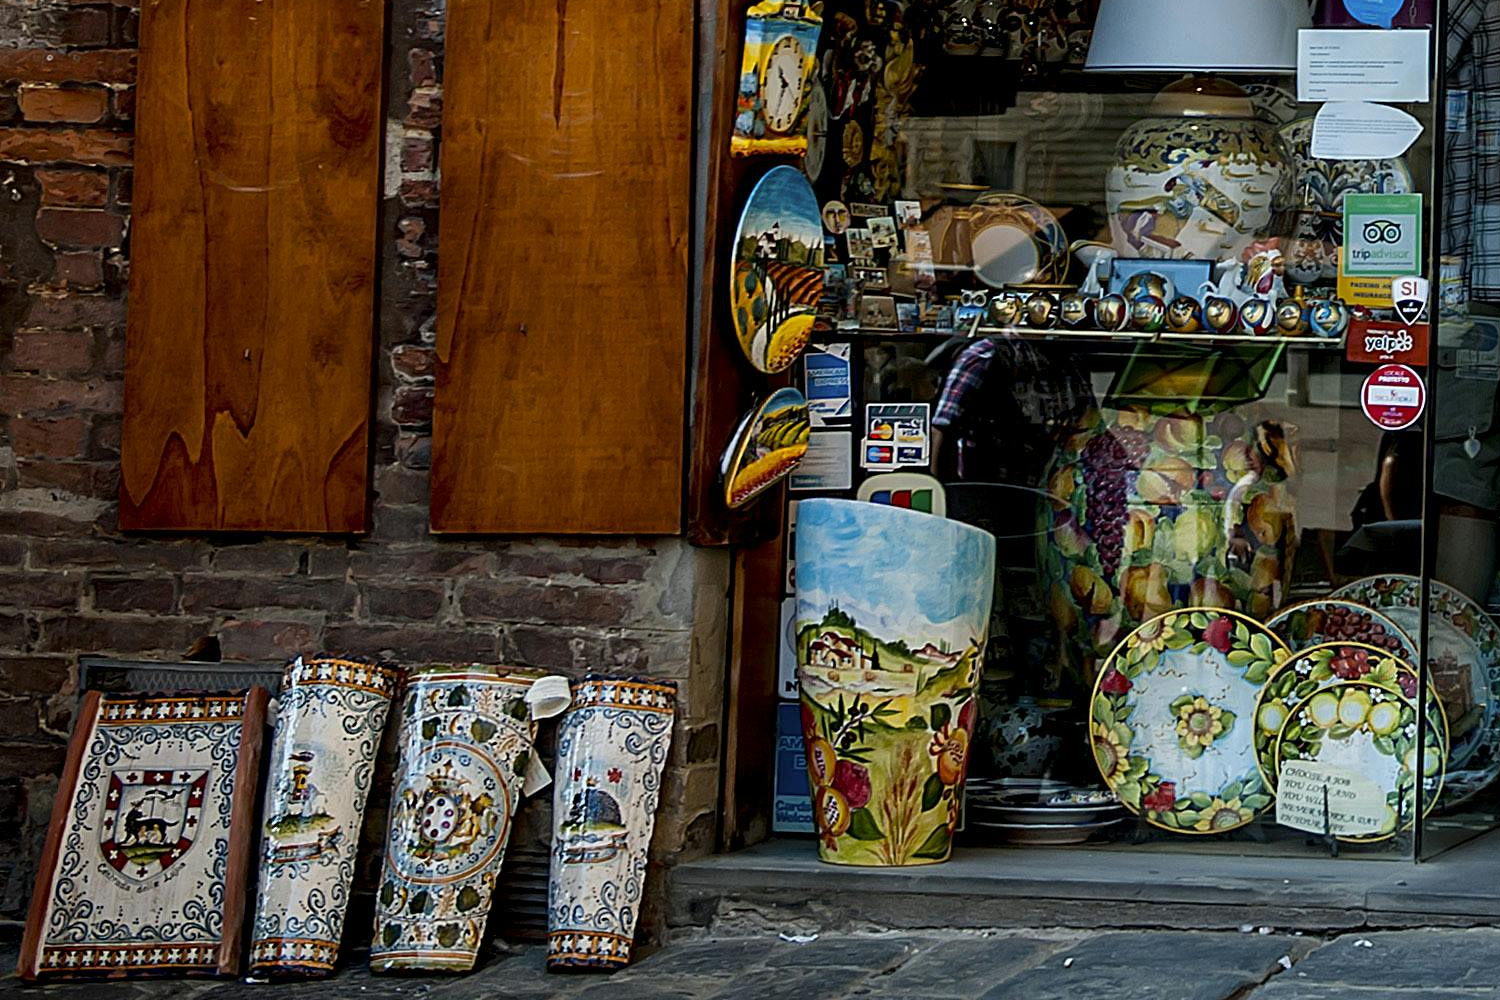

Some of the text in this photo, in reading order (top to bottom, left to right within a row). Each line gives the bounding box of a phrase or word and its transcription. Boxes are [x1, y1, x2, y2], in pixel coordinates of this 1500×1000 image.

[1352, 248, 1409, 261] tripadvisor
[1400, 280, 1418, 297] SI
[1366, 335, 1397, 353] yelp
[807, 367, 847, 377] AMERICAN
[814, 377, 849, 387] EXPRESS
[1285, 767, 1351, 786] CHOOSE A JOB
[1282, 791, 1304, 801] YOU
[1284, 779, 1305, 790] YOU
[1333, 789, 1357, 799] AND
[1280, 802, 1315, 817] NEVER
[1356, 816, 1380, 826] DAY
